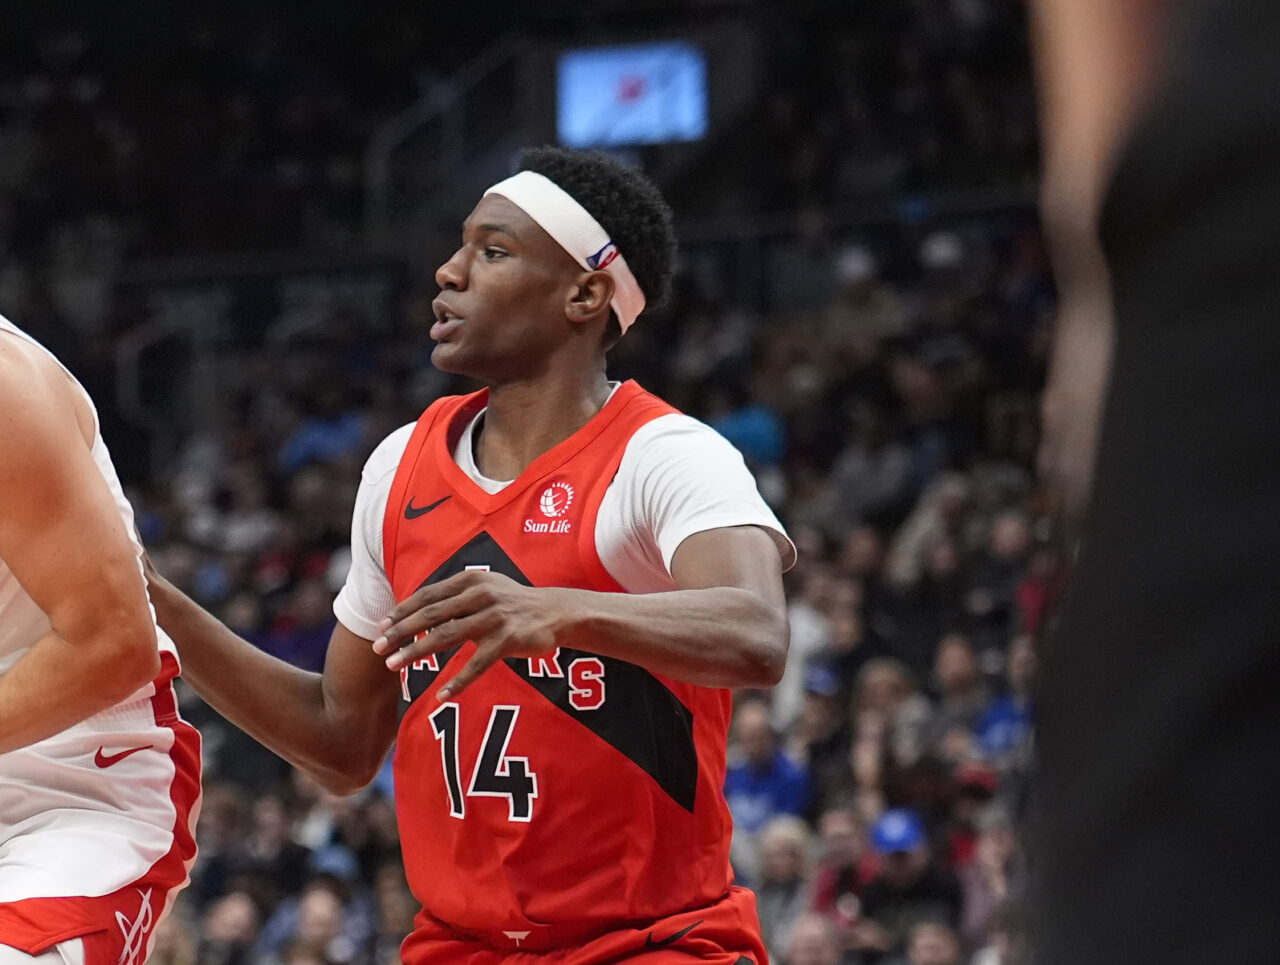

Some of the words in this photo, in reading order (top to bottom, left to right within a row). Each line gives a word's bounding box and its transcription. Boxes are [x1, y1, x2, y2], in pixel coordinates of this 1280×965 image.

[523, 519, 548, 533] Sun
[549, 519, 571, 533] Life
[428, 702, 538, 822] 14
